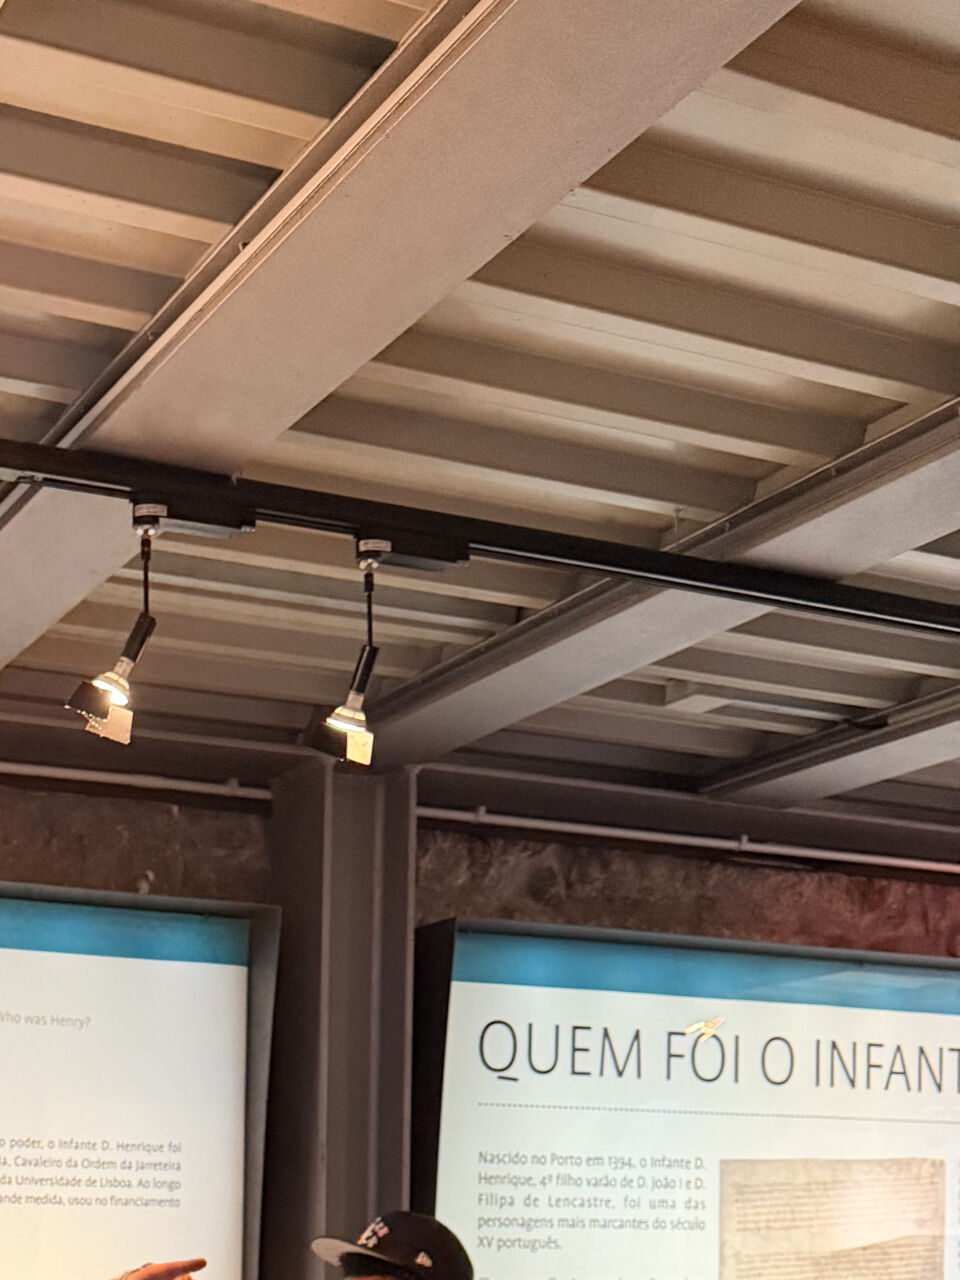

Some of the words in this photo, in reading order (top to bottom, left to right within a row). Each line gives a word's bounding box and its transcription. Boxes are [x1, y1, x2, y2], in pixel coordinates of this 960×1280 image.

[24, 1014, 47, 1026] was
[50, 1014, 92, 1031] Henry?
[478, 1019, 643, 1083] QUEM
[665, 1031, 740, 1084] FOI
[760, 1036, 796, 1086] O
[814, 1038, 960, 1095] INFANT
[9, 1137, 44, 1151] poder,
[47, 1139, 55, 1149] o
[58, 1137, 98, 1151] Infante
[101, 1140, 112, 1151] D.
[116, 1140, 165, 1155] Henrique
[168, 1141, 182, 1153] foi
[14, 1155, 63, 1169] Cavaleiro
[65, 1156, 79, 1169] da
[81, 1157, 117, 1170] Ordem
[120, 1158, 133, 1171] da
[478, 1151, 528, 1166] Nascido
[530, 1154, 546, 1166] no
[550, 1153, 582, 1167] Porto
[585, 1156, 604, 1167] em
[607, 1156, 637, 1171] 1394,
[639, 1157, 647, 1168] o
[650, 1155, 691, 1170] Infante
[694, 1157, 706, 1170] D.
[0, 1174, 12, 1187] da
[15, 1175, 82, 1188] Universidade
[84, 1176, 97, 1189] de
[100, 1176, 133, 1190] Lisboa.
[137, 1178, 151, 1190] Ao
[153, 1178, 182, 1193] longo
[478, 1173, 537, 1189] Henrique,
[556, 1173, 583, 1188] filho
[585, 1175, 617, 1189] varão
[620, 1175, 634, 1189] de
[637, 1176, 649, 1189] D.
[651, 1176, 677, 1191] João
[685, 1179, 692, 1190] e
[694, 1177, 706, 1190] D.
[25, 1194, 65, 1208] medida,
[68, 1197, 93, 1208] usou
[95, 1197, 108, 1208] no
[110, 1195, 182, 1210] financiamento
[478, 1193, 515, 1210] Filipa
[523, 1194, 540, 1208] de
[547, 1195, 616, 1210] Lencastre,
[624, 1195, 641, 1209] foi
[649, 1198, 677, 1210] uma
[684, 1196, 706, 1210] das
[477, 1215, 554, 1232] personagens
[557, 1215, 586, 1229] mais
[589, 1217, 650, 1231] marcantes
[652, 1216, 667, 1231] do
[669, 1216, 706, 1231] século
[477, 1236, 494, 1249] XV
[496, 1236, 563, 1253] português.
